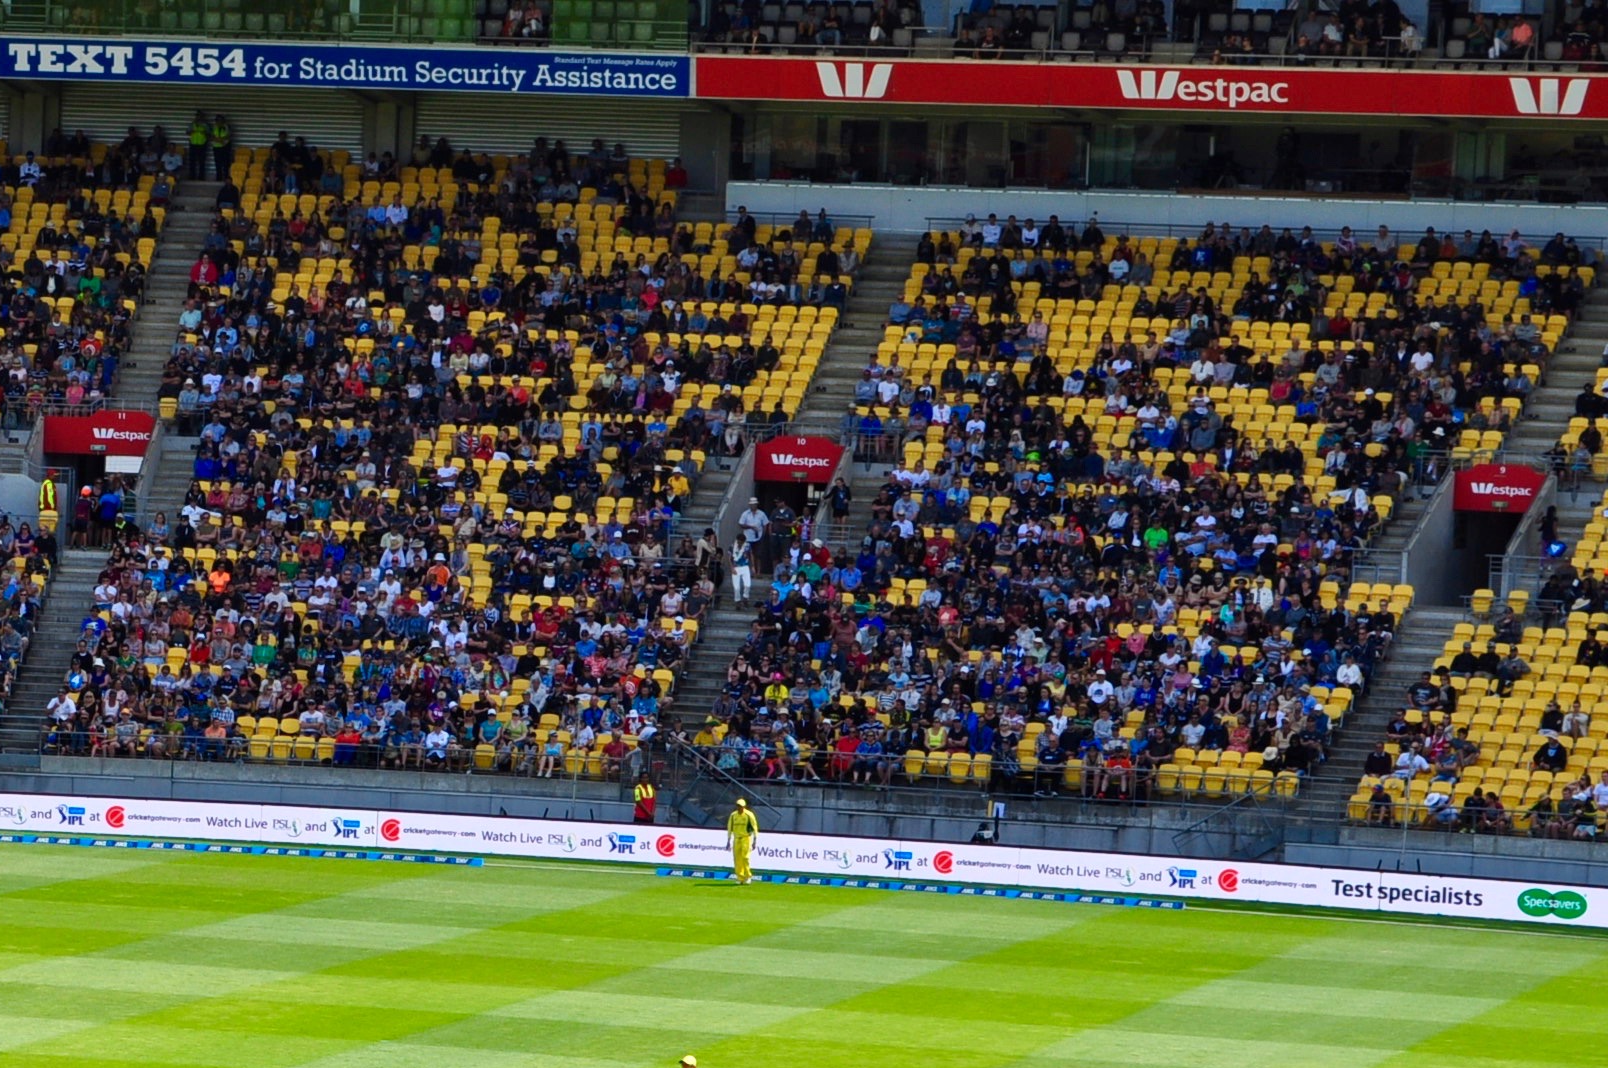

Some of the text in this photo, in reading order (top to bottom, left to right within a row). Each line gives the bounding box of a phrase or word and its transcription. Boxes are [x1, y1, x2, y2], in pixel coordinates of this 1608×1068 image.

[9, 43, 677, 91] TEXT 5454 for Stadium Security Assistance
[1116, 70, 1289, 108] Westpac
[92, 427, 151, 441] Westpac
[797, 438, 807, 446] 10
[771, 453, 830, 469] Westpac
[1499, 466, 1507, 474] 9
[1470, 481, 1532, 497] Westpac
[31, 810, 52, 819] and
[68, 816, 84, 825] IPL
[90, 813, 100, 821] at
[206, 817, 241, 827] Watch
[245, 818, 268, 829] Live
[273, 819, 292, 828] PSL
[305, 822, 326, 831] and
[343, 829, 359, 838] IPL
[364, 826, 375, 834] at
[482, 831, 516, 842] Watch
[520, 834, 543, 844] Live
[548, 833, 568, 843] PSL
[580, 837, 602, 847] and
[618, 844, 634, 853] IPL
[757, 847, 792, 858] Watch
[796, 849, 818, 860] Live
[824, 849, 845, 862] PSL
[857, 854, 878, 863] and
[896, 859, 911, 870] IPL
[917, 858, 927, 866] at
[1037, 864, 1073, 875] Watch
[1077, 867, 1100, 877] Live
[1104, 867, 1124, 877] PSL
[1139, 872, 1162, 881] and
[1177, 878, 1196, 889] IPL
[1201, 875, 1213, 885] at
[1331, 880, 1483, 907] Test specialists
[1523, 895, 1581, 911] Specsavers
